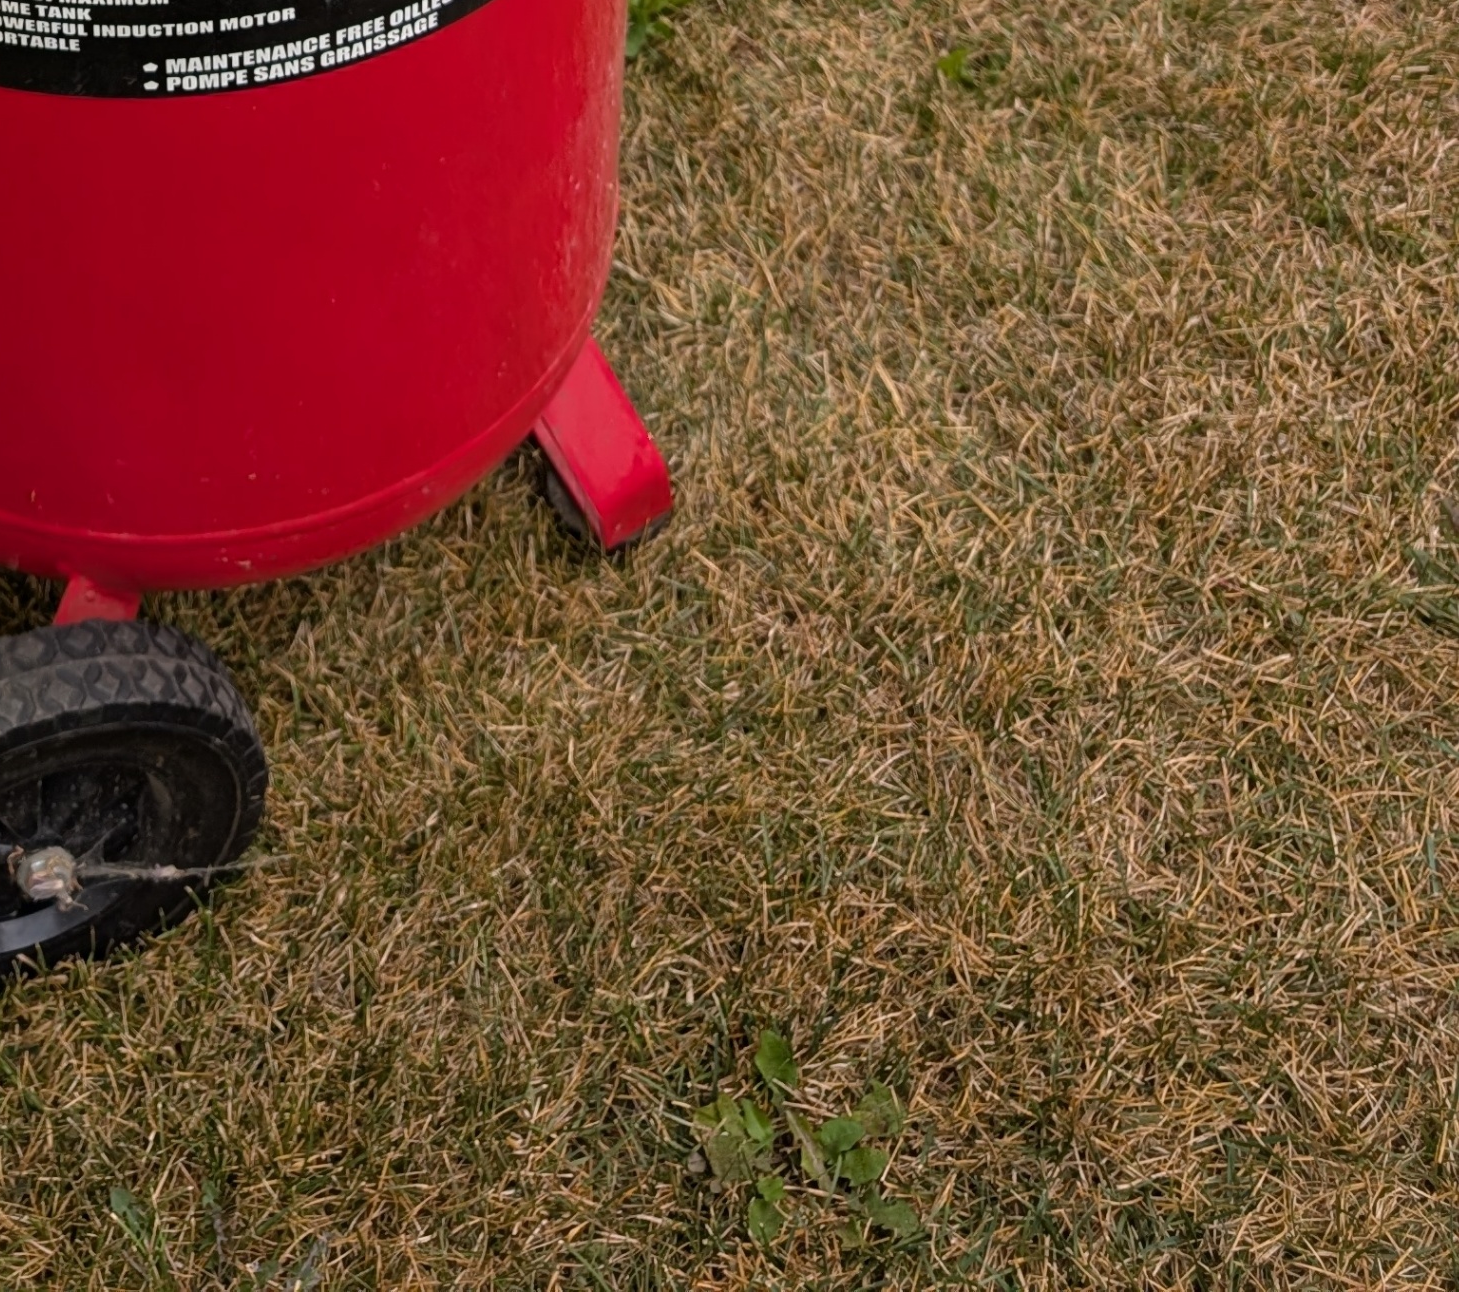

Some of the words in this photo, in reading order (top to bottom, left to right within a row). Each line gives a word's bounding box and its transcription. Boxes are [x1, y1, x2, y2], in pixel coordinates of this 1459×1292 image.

[35, 4, 92, 20] TANK
[93, 20, 214, 37] INDUCTION
[219, 7, 296, 31] MOTOR
[166, 33, 331, 74] MAINTENANCE
[336, 16, 385, 46] FREE
[166, 70, 248, 91] POMPE
[254, 55, 314, 82] SANS
[320, 13, 439, 67] GRAISSAGE
